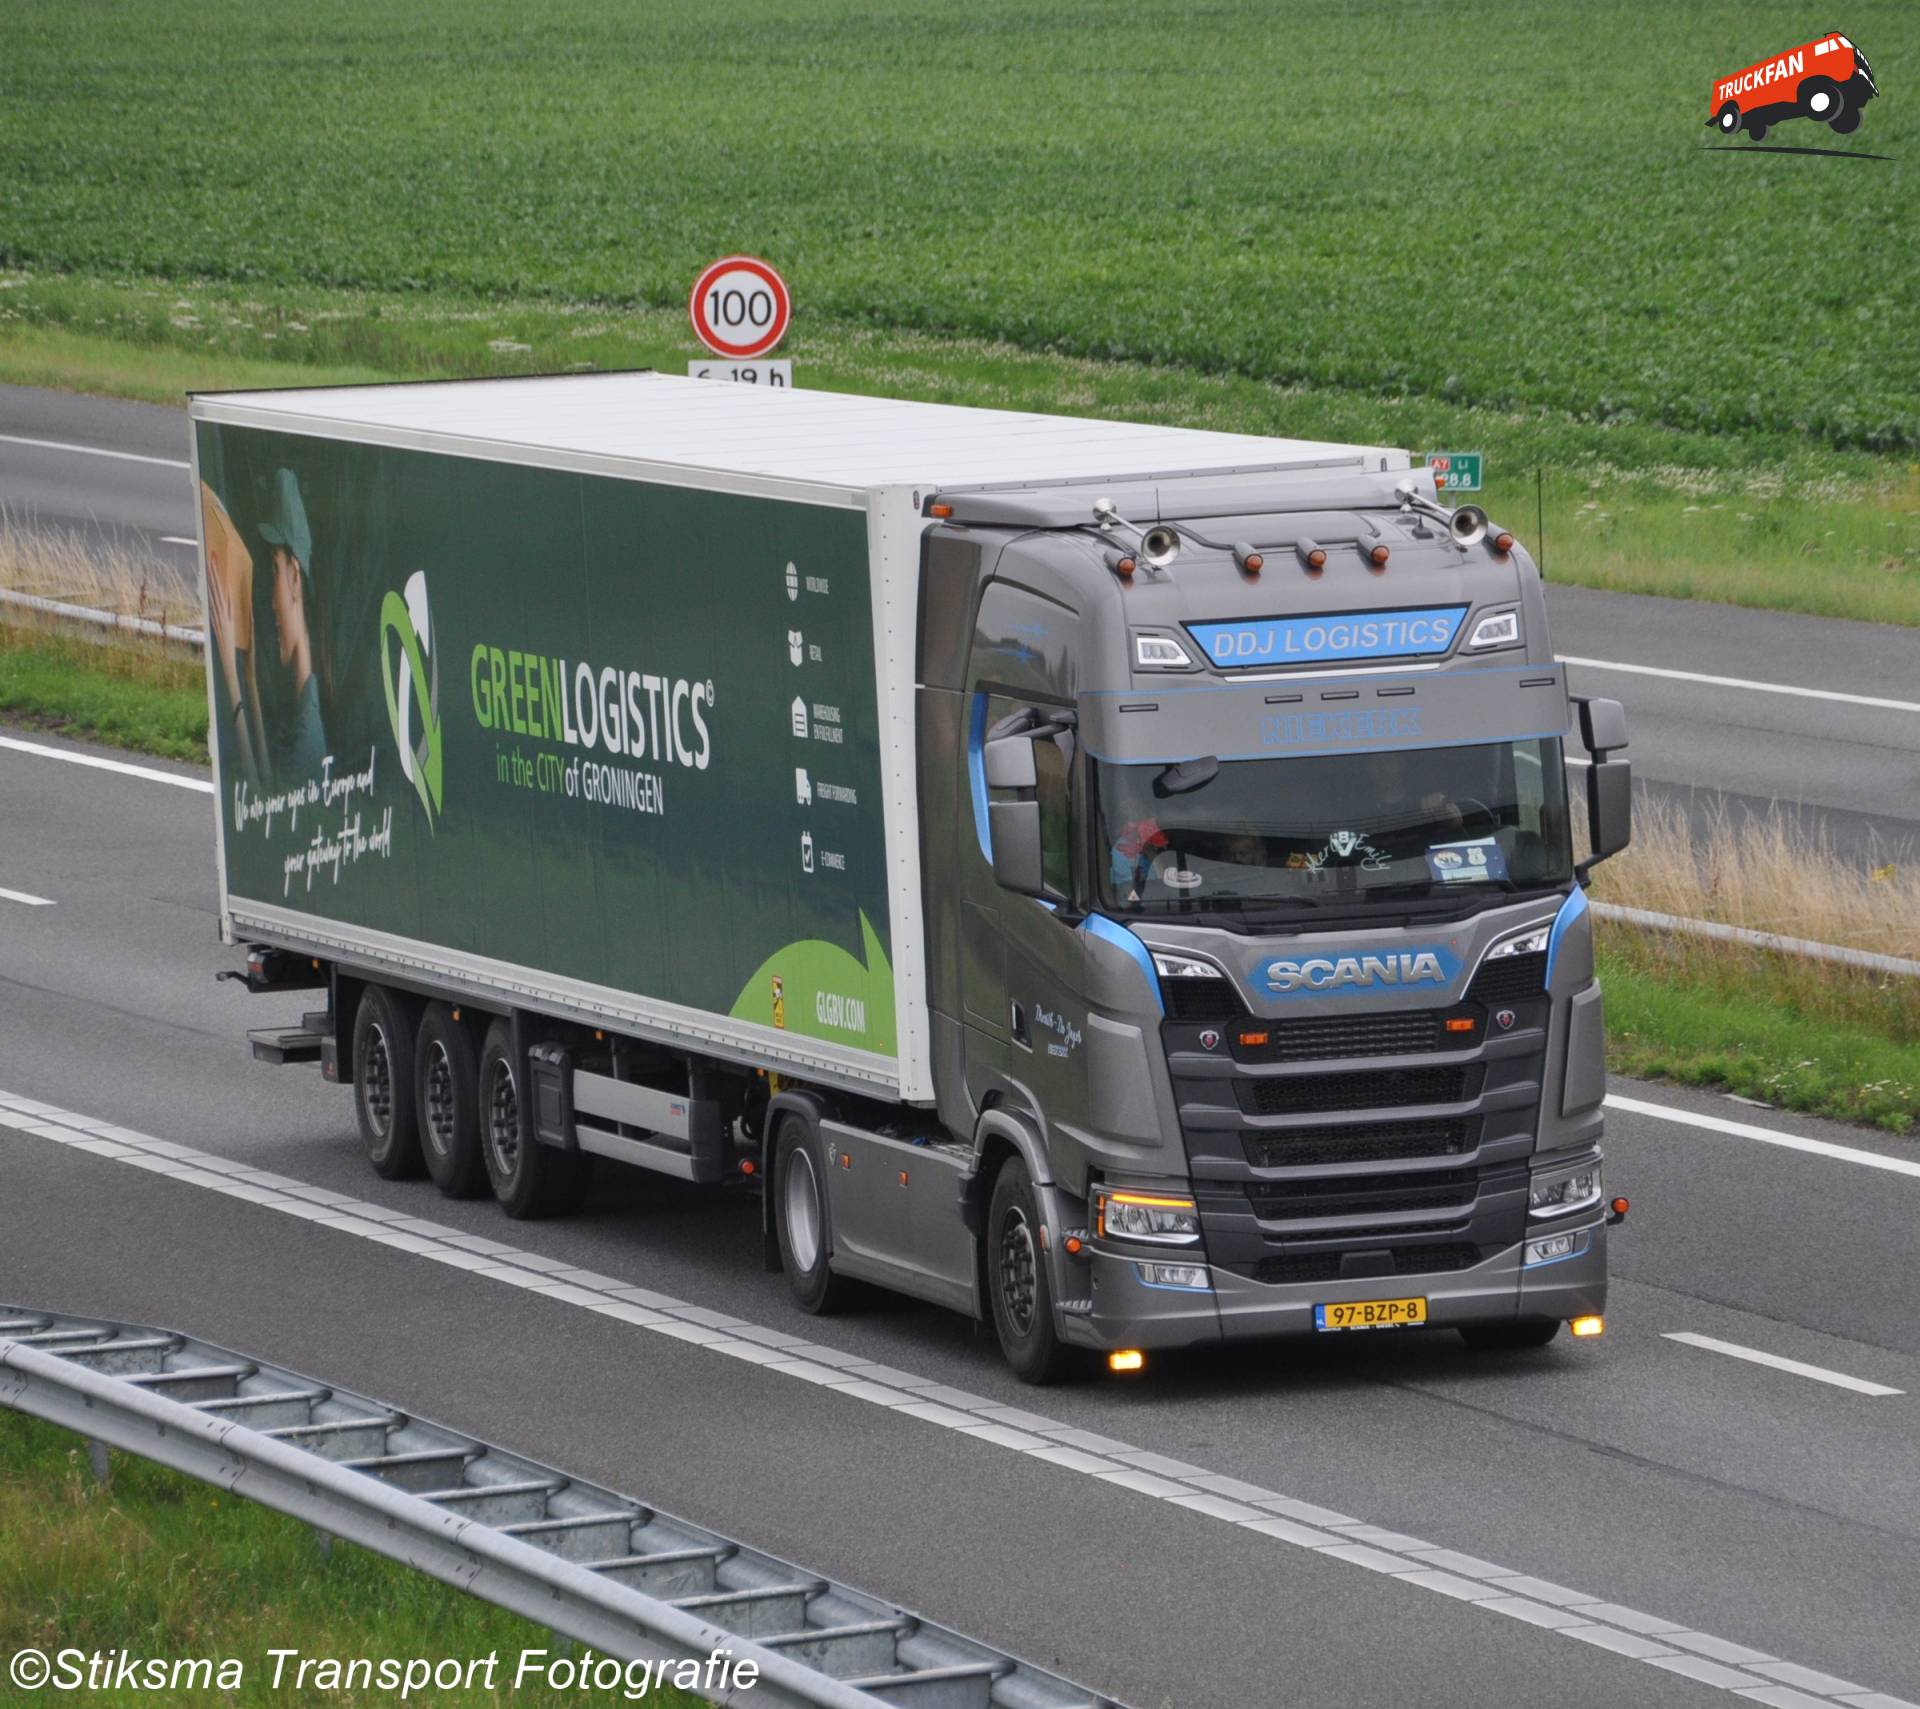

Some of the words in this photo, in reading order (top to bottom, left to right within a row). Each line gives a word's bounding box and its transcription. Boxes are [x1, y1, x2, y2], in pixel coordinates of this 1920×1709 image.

[709, 289, 772, 327] 100
[1214, 630, 1275, 657] DDJ
[1284, 618, 1451, 653] LOGISTICS
[322, 755, 356, 816] Europe
[496, 743, 509, 784] in
[512, 746, 534, 788] the
[537, 752, 565, 794] CITY
[565, 756, 580, 798] of
[582, 761, 664, 816] GRONINGEN
[1266, 952, 1446, 993] SCANIA
[816, 990, 866, 1033] GLGBV.COM
[1333, 1302, 1418, 1324] 97-BZP-8
